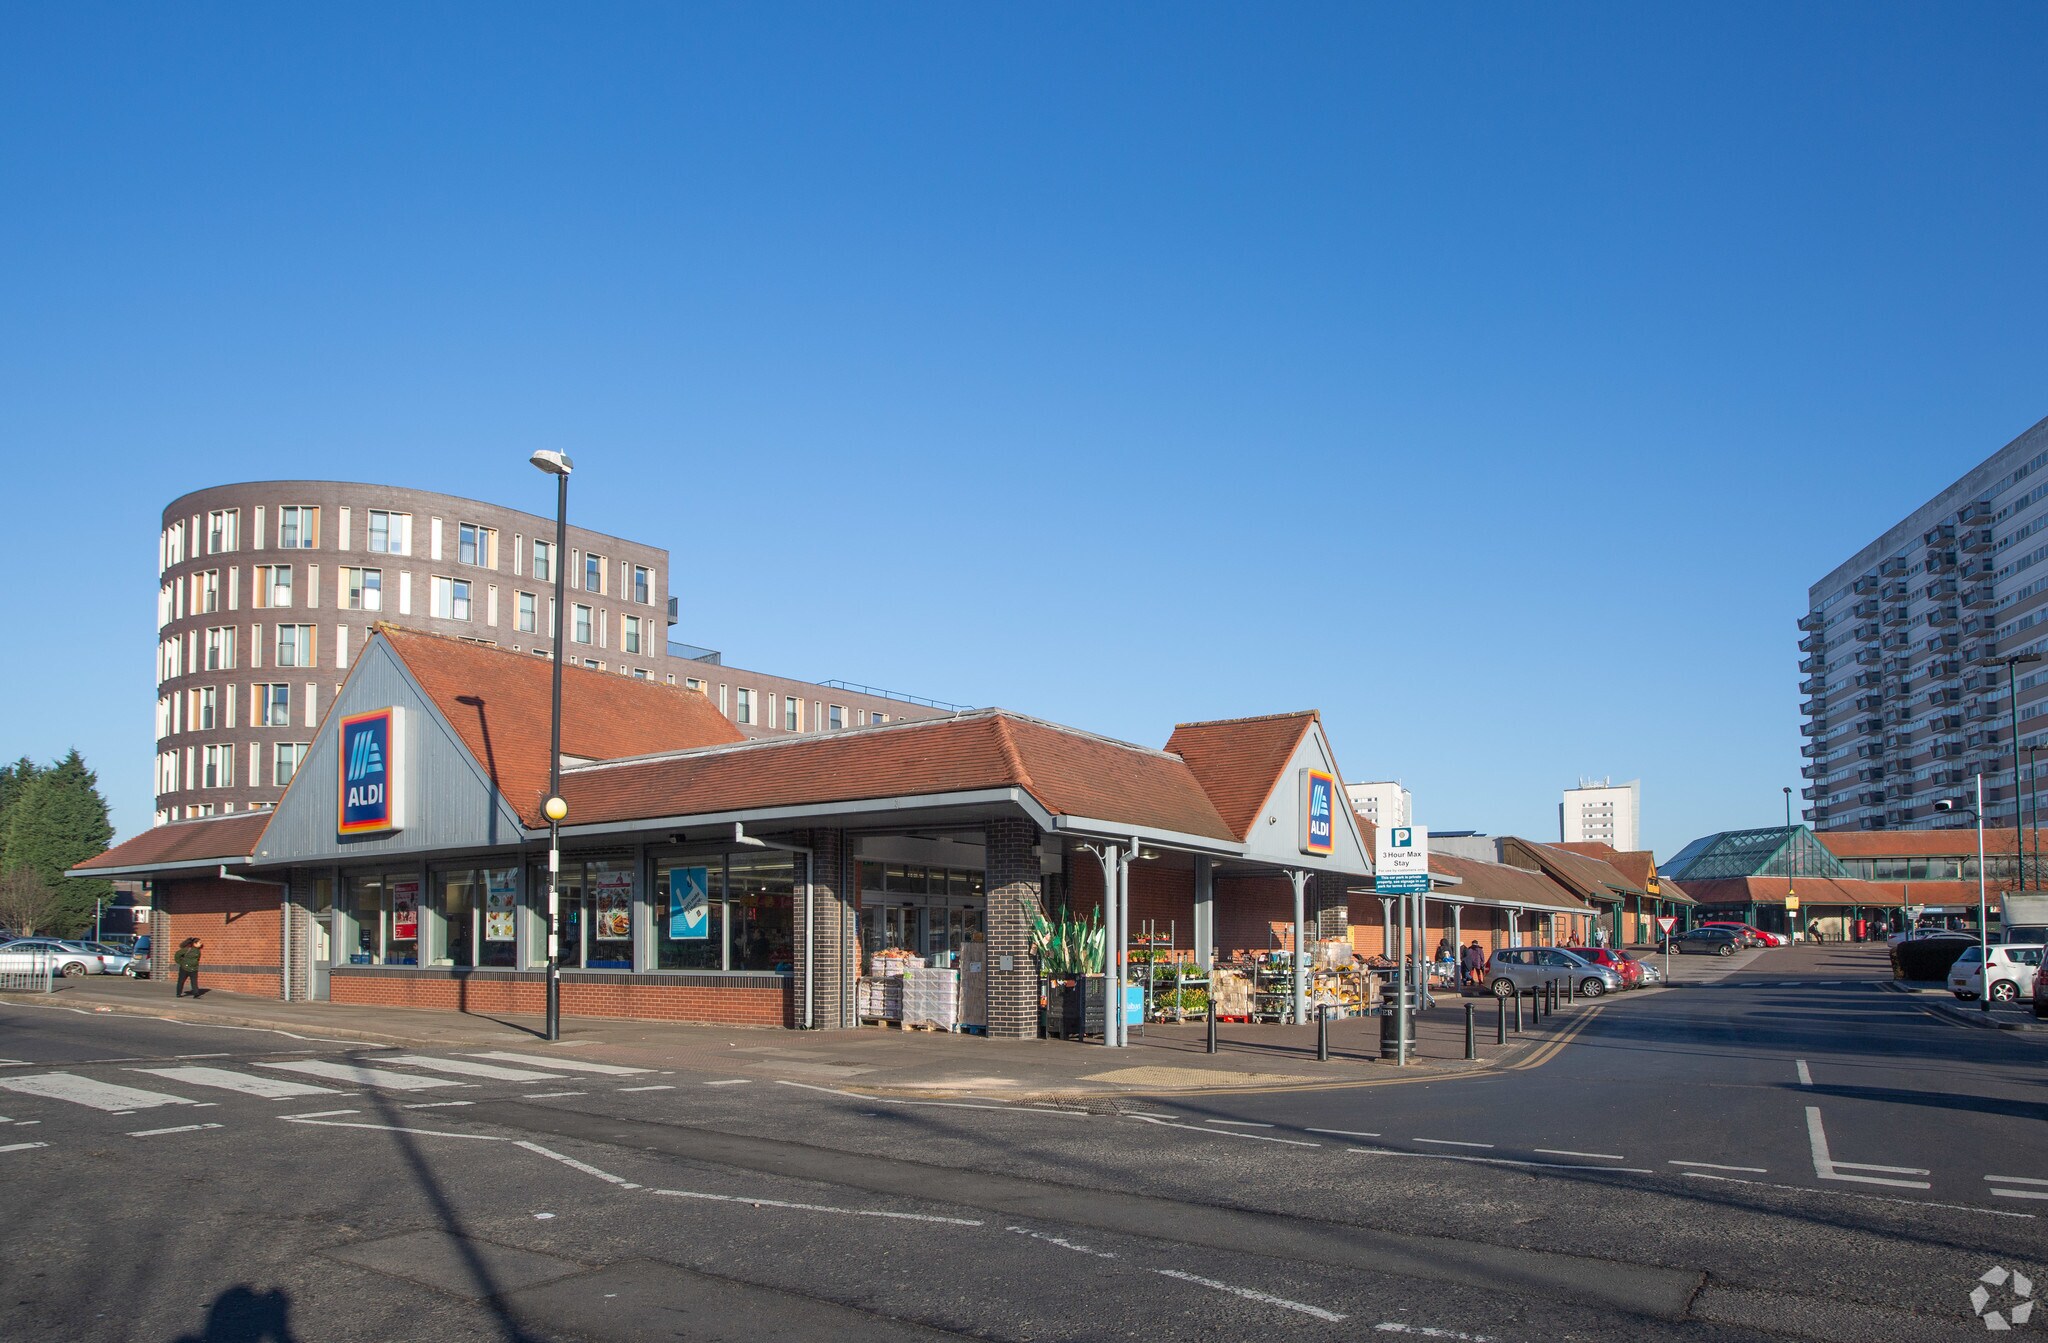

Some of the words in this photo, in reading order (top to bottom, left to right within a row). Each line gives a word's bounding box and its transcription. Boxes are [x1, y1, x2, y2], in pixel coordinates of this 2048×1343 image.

[348, 783, 384, 808] ALDI
[1310, 820, 1329, 836] ALDI
[1394, 830, 1410, 846] P
